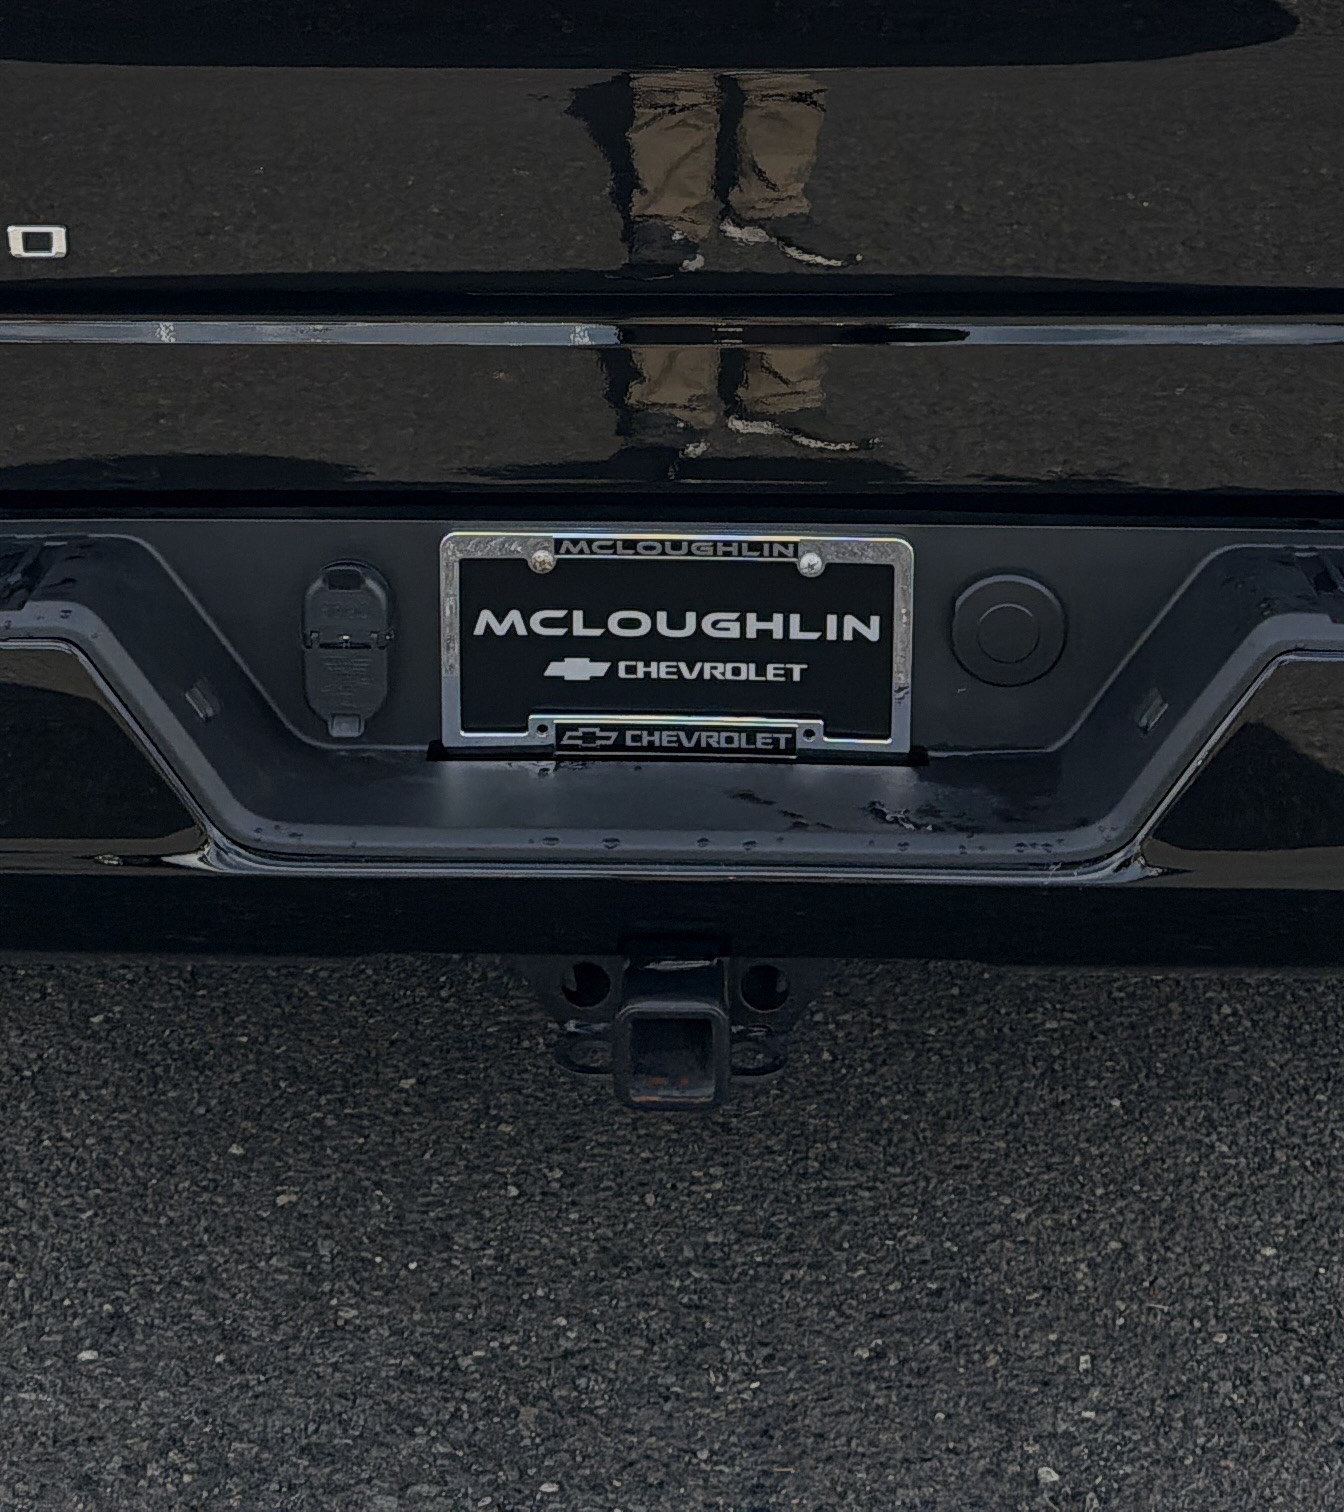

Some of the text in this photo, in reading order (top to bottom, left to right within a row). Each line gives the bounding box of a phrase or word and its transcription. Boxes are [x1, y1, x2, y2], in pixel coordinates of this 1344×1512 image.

[558, 539, 796, 558] MCLOUGHLIN
[473, 609, 881, 642] MCLOUGHLIN
[617, 660, 808, 683] CHEVROLET
[625, 729, 793, 750] CHEVROLET
